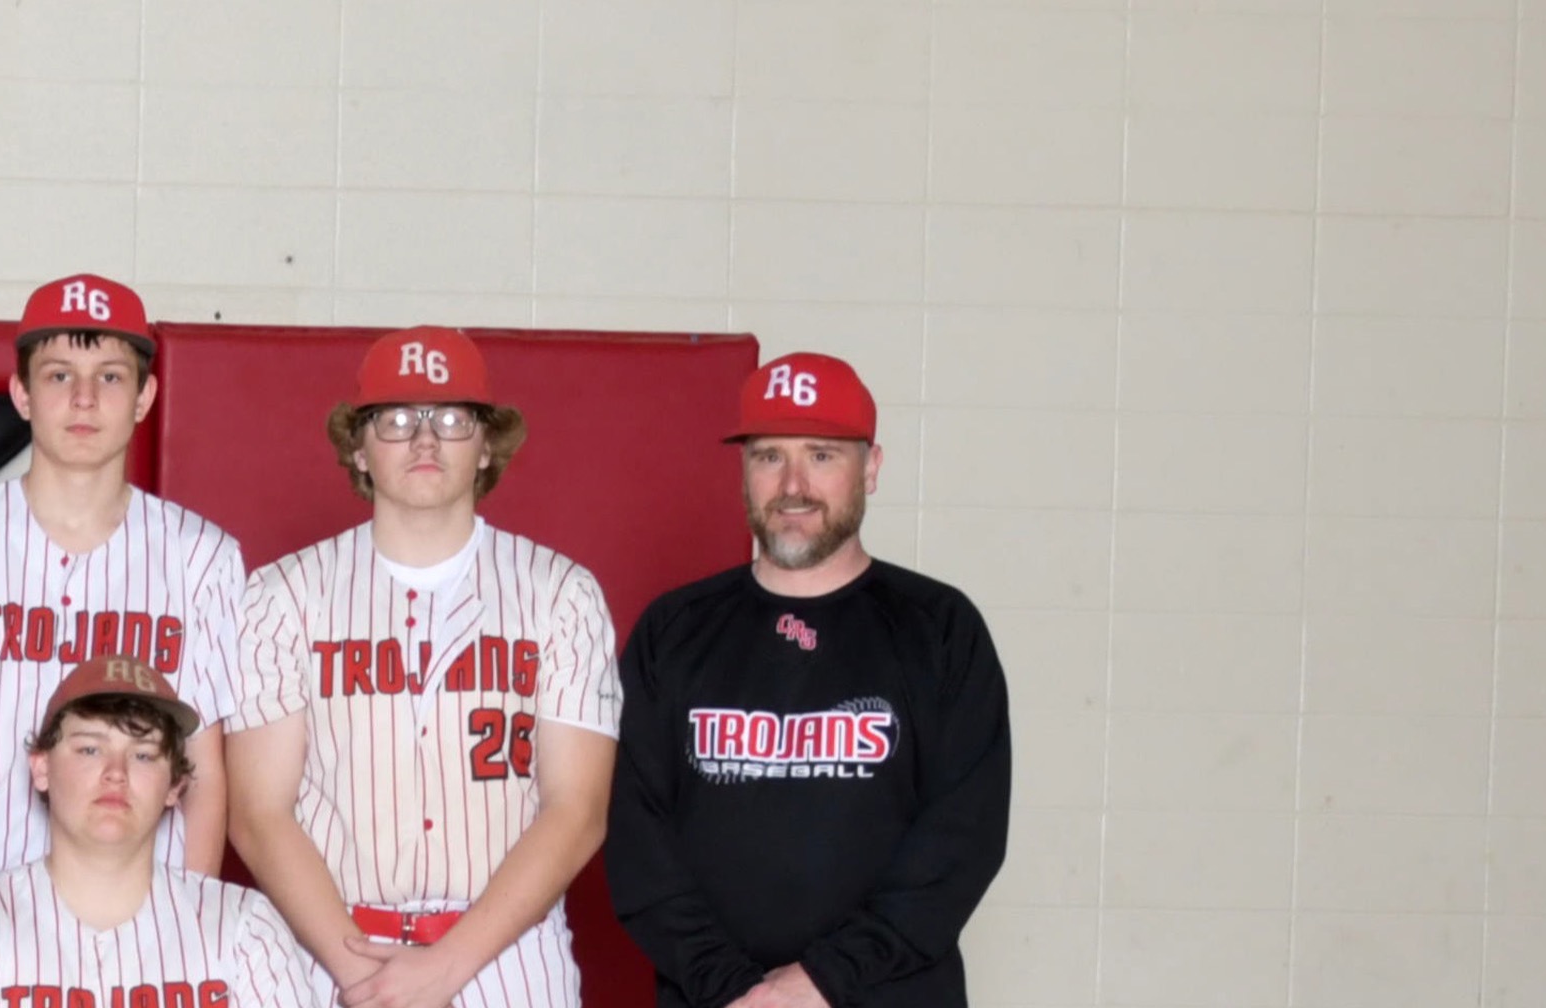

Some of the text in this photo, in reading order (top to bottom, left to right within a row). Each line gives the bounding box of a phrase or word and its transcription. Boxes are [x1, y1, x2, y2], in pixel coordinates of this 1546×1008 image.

[61, 280, 113, 322] R6
[398, 340, 450, 385] R6
[763, 363, 818, 407] R6
[105, 657, 157, 693] R6
[689, 709, 891, 764] TROJANS
[699, 761, 874, 779] BASEBALL
